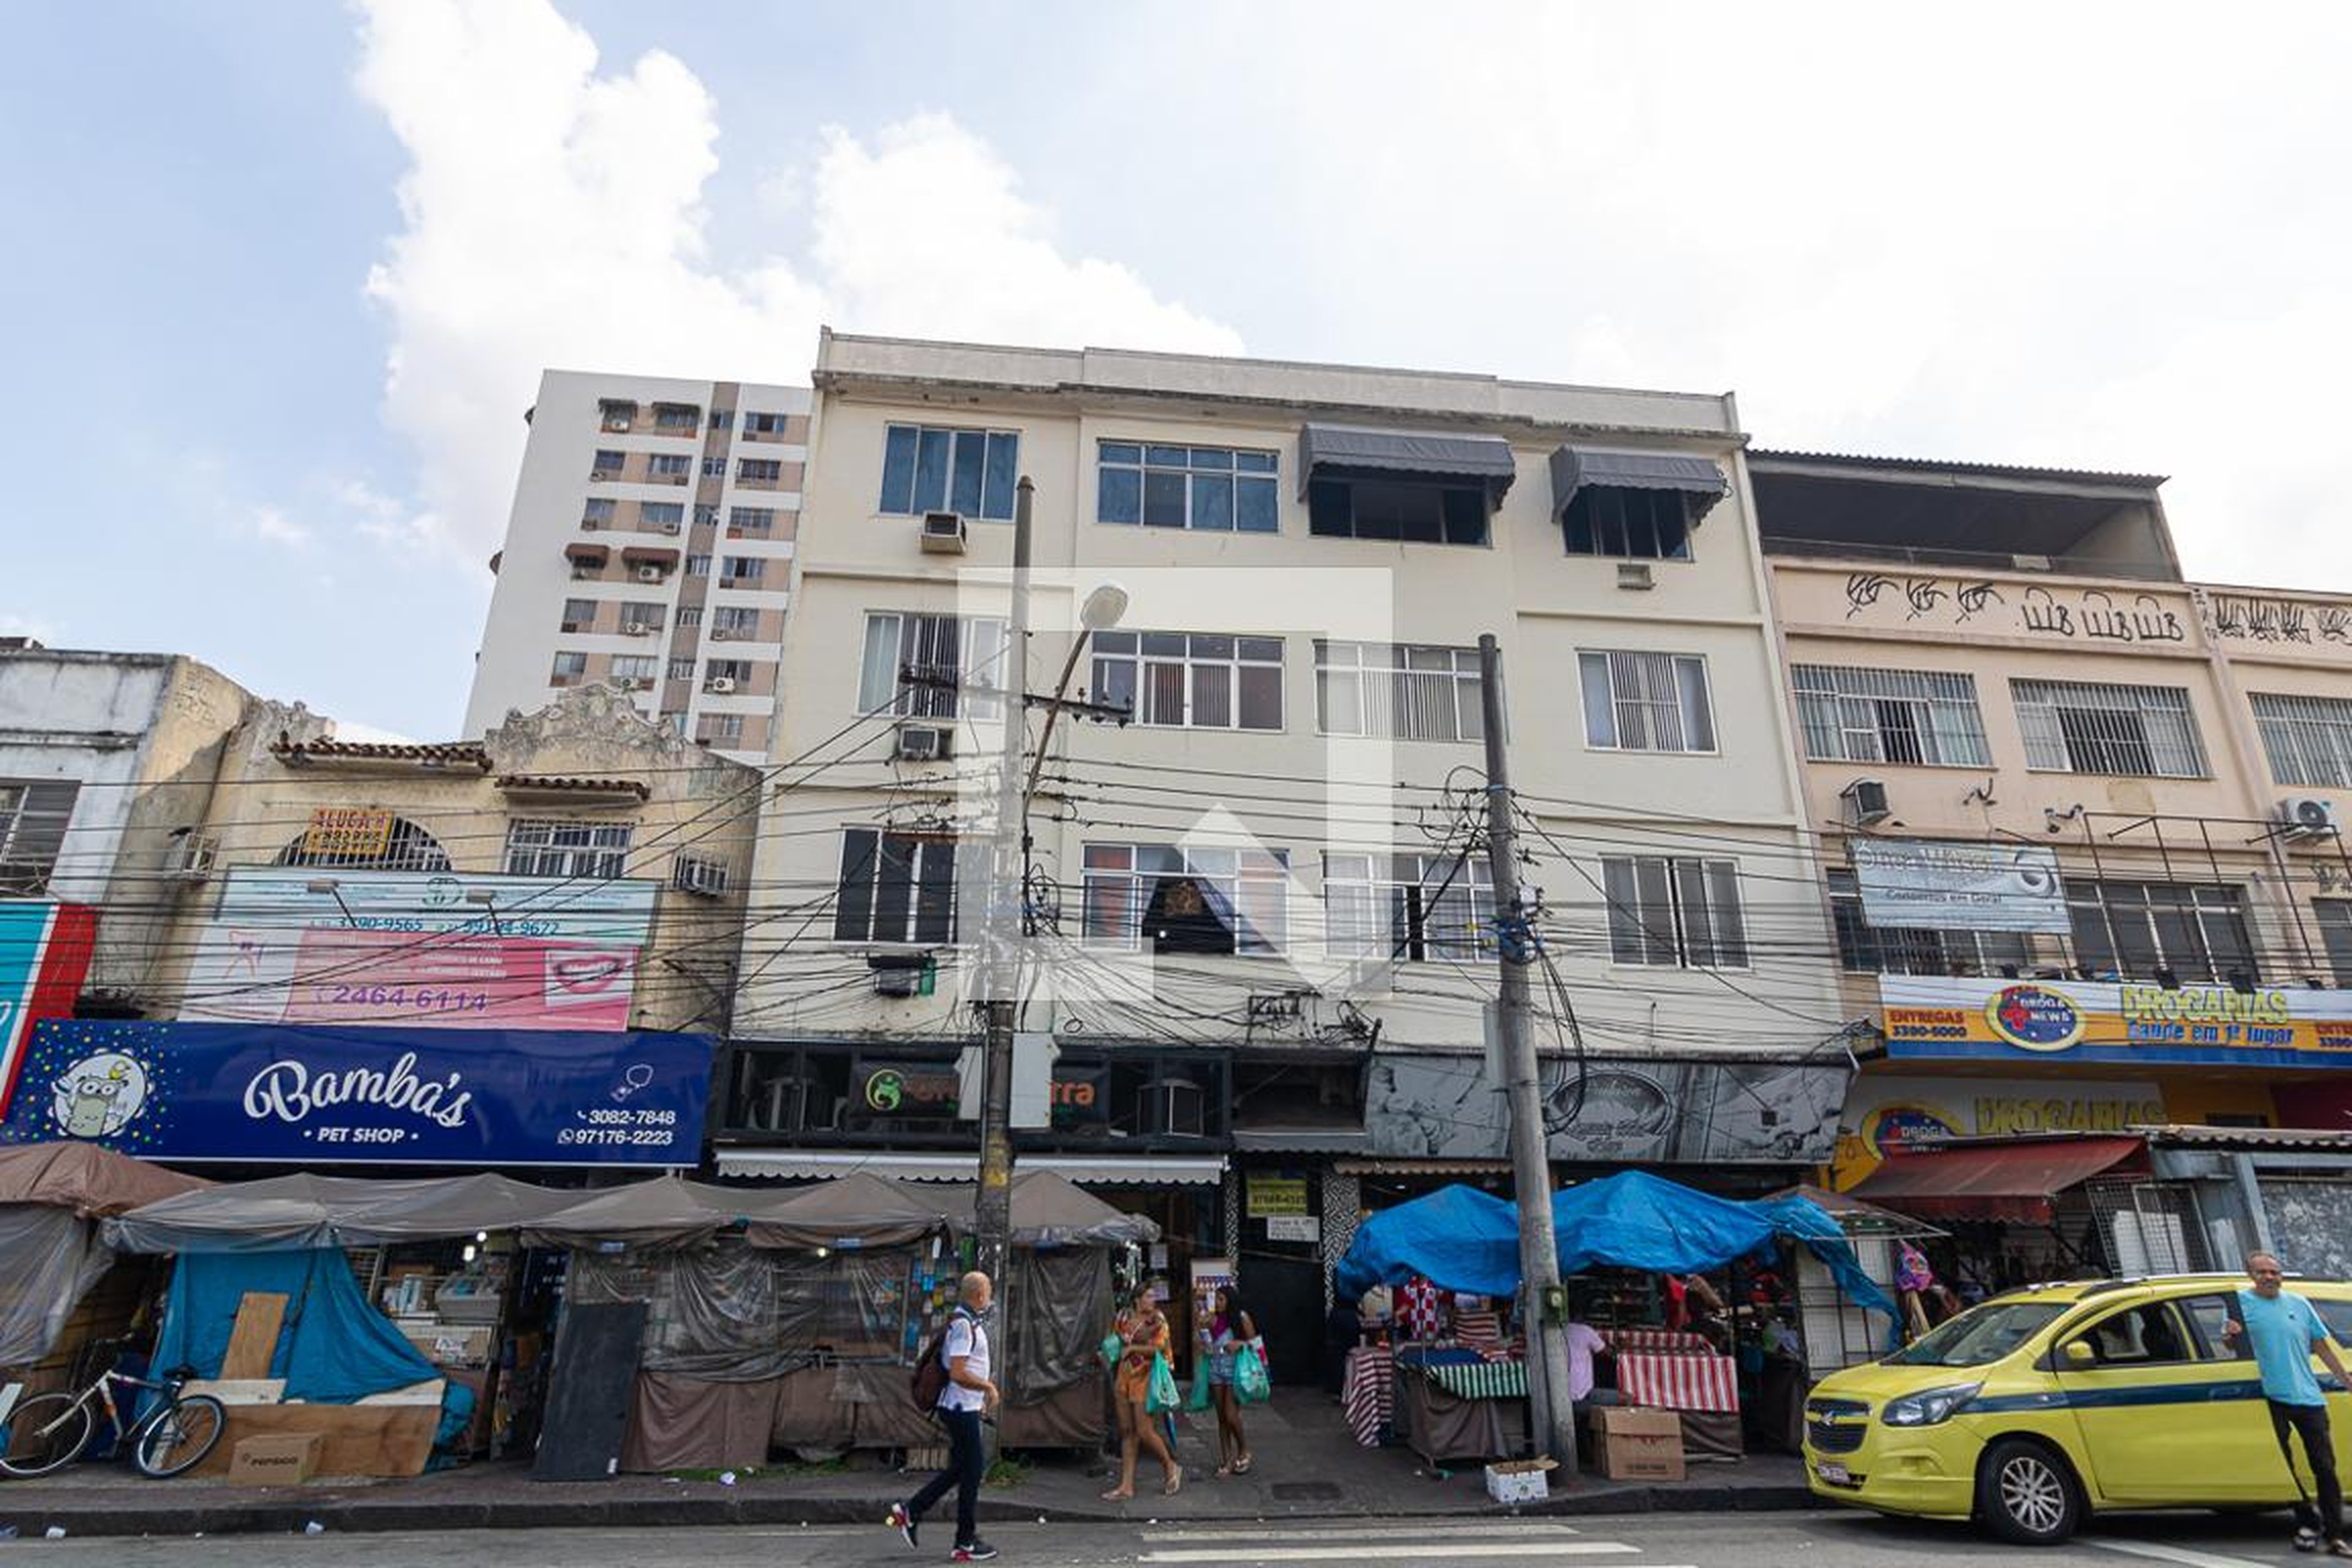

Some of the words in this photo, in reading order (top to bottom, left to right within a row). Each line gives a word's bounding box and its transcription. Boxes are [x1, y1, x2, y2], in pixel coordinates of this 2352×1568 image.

[339, 918, 424, 931] 390-9565
[2122, 986, 2288, 1025] DROGARIAS
[1890, 1010, 1964, 1024] ENTREGAS
[2193, 1025, 2218, 1041] em
[2247, 1025, 2294, 1046] lugar
[244, 1052, 472, 1128] Bamba's
[589, 1110, 676, 1125] 3082-7848
[317, 1127, 350, 1143] PET
[353, 1128, 405, 1144] SHOP
[575, 1129, 673, 1145] 97176-2223
